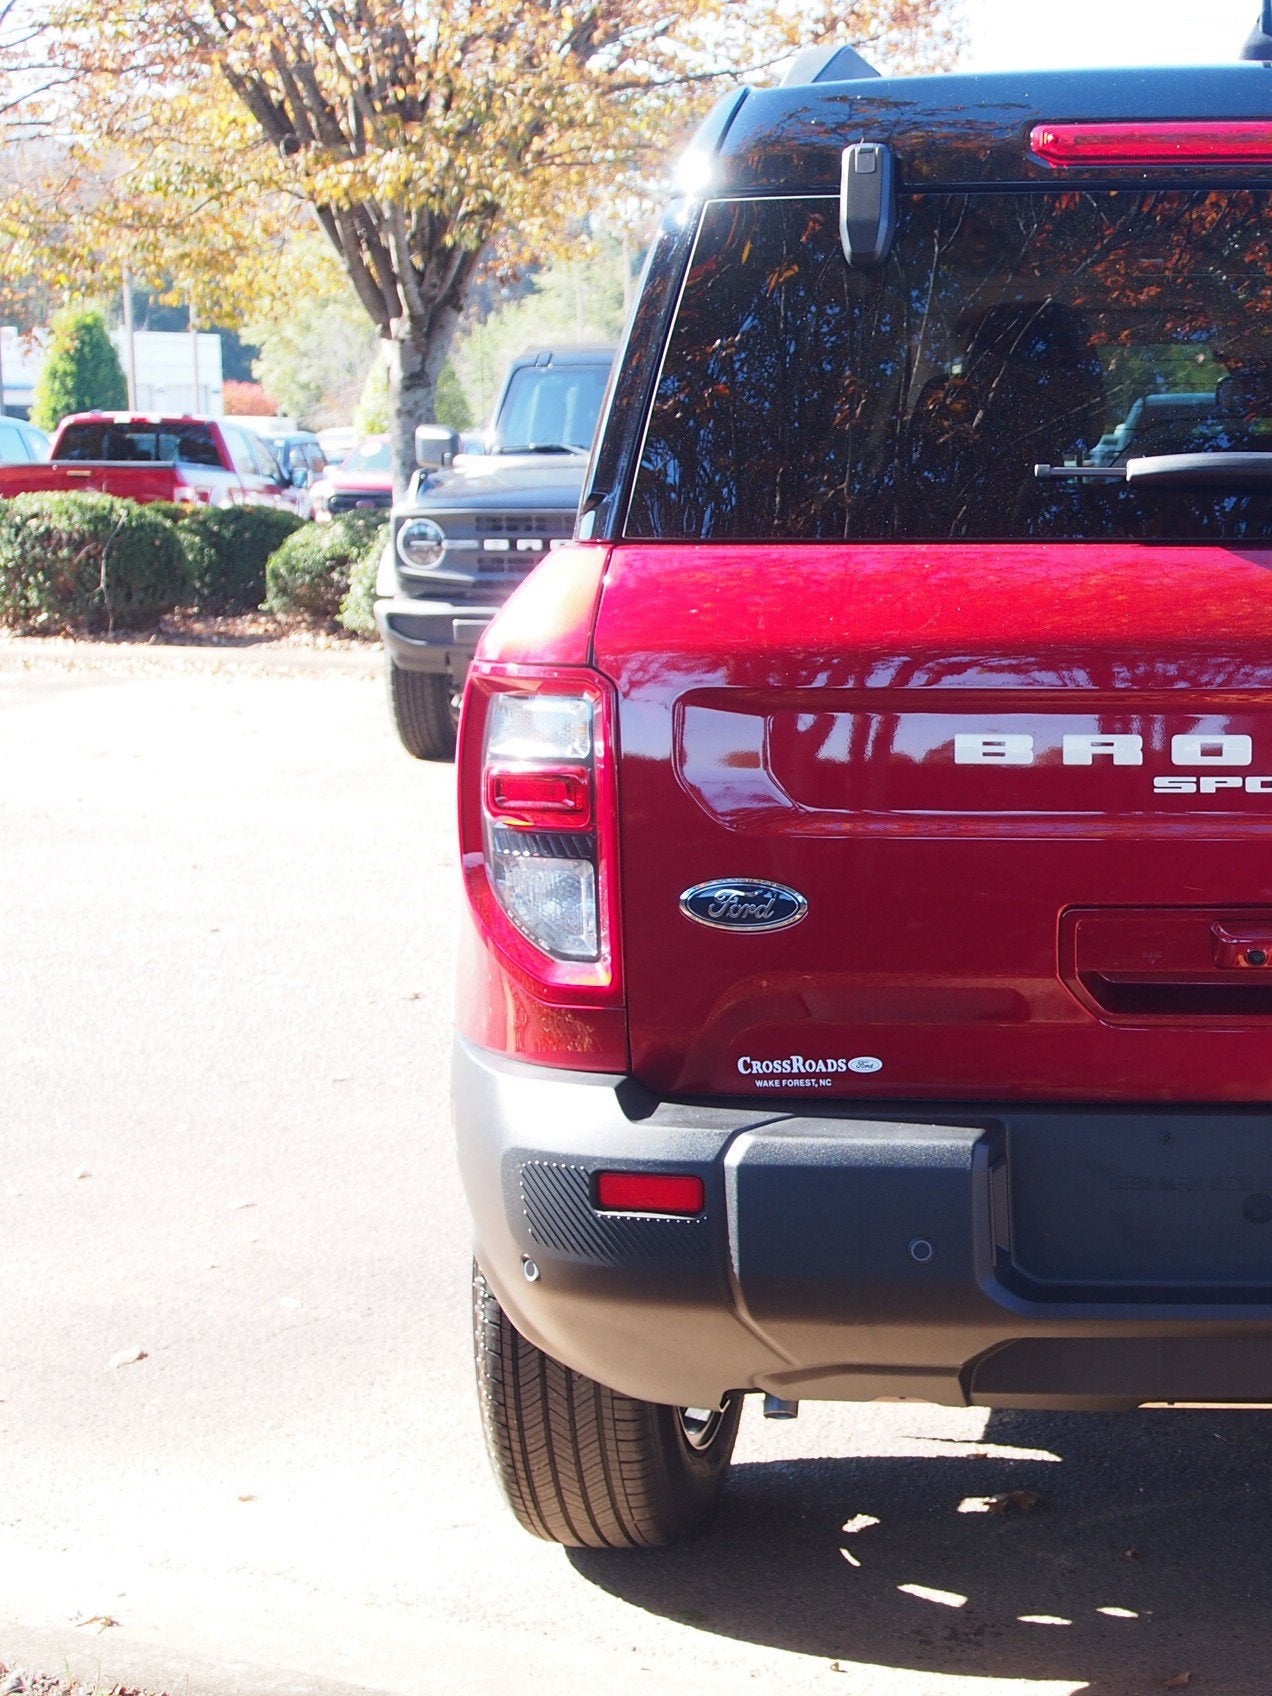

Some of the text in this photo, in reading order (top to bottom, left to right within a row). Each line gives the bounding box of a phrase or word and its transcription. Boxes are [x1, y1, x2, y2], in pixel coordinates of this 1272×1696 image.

[707, 888, 778, 919] Ford
[755, 1078, 832, 1088] WAKE FOREST, NC
